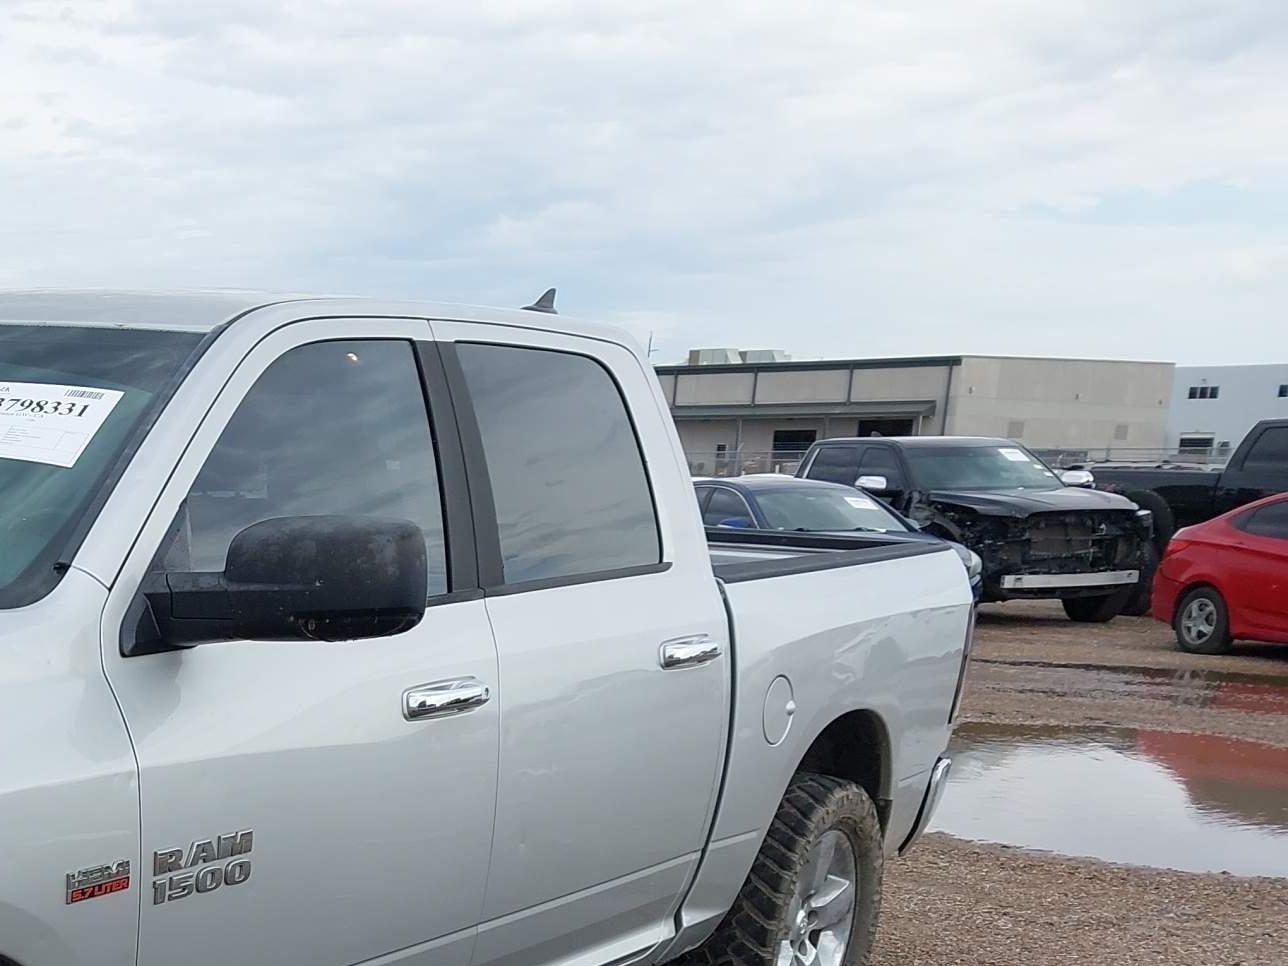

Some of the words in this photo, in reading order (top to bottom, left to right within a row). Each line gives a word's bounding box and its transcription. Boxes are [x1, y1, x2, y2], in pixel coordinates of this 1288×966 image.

[153, 828, 254, 876] RAM
[72, 888, 93, 901] 5.7
[94, 879, 128, 895] LITER
[153, 859, 252, 905] 1500
